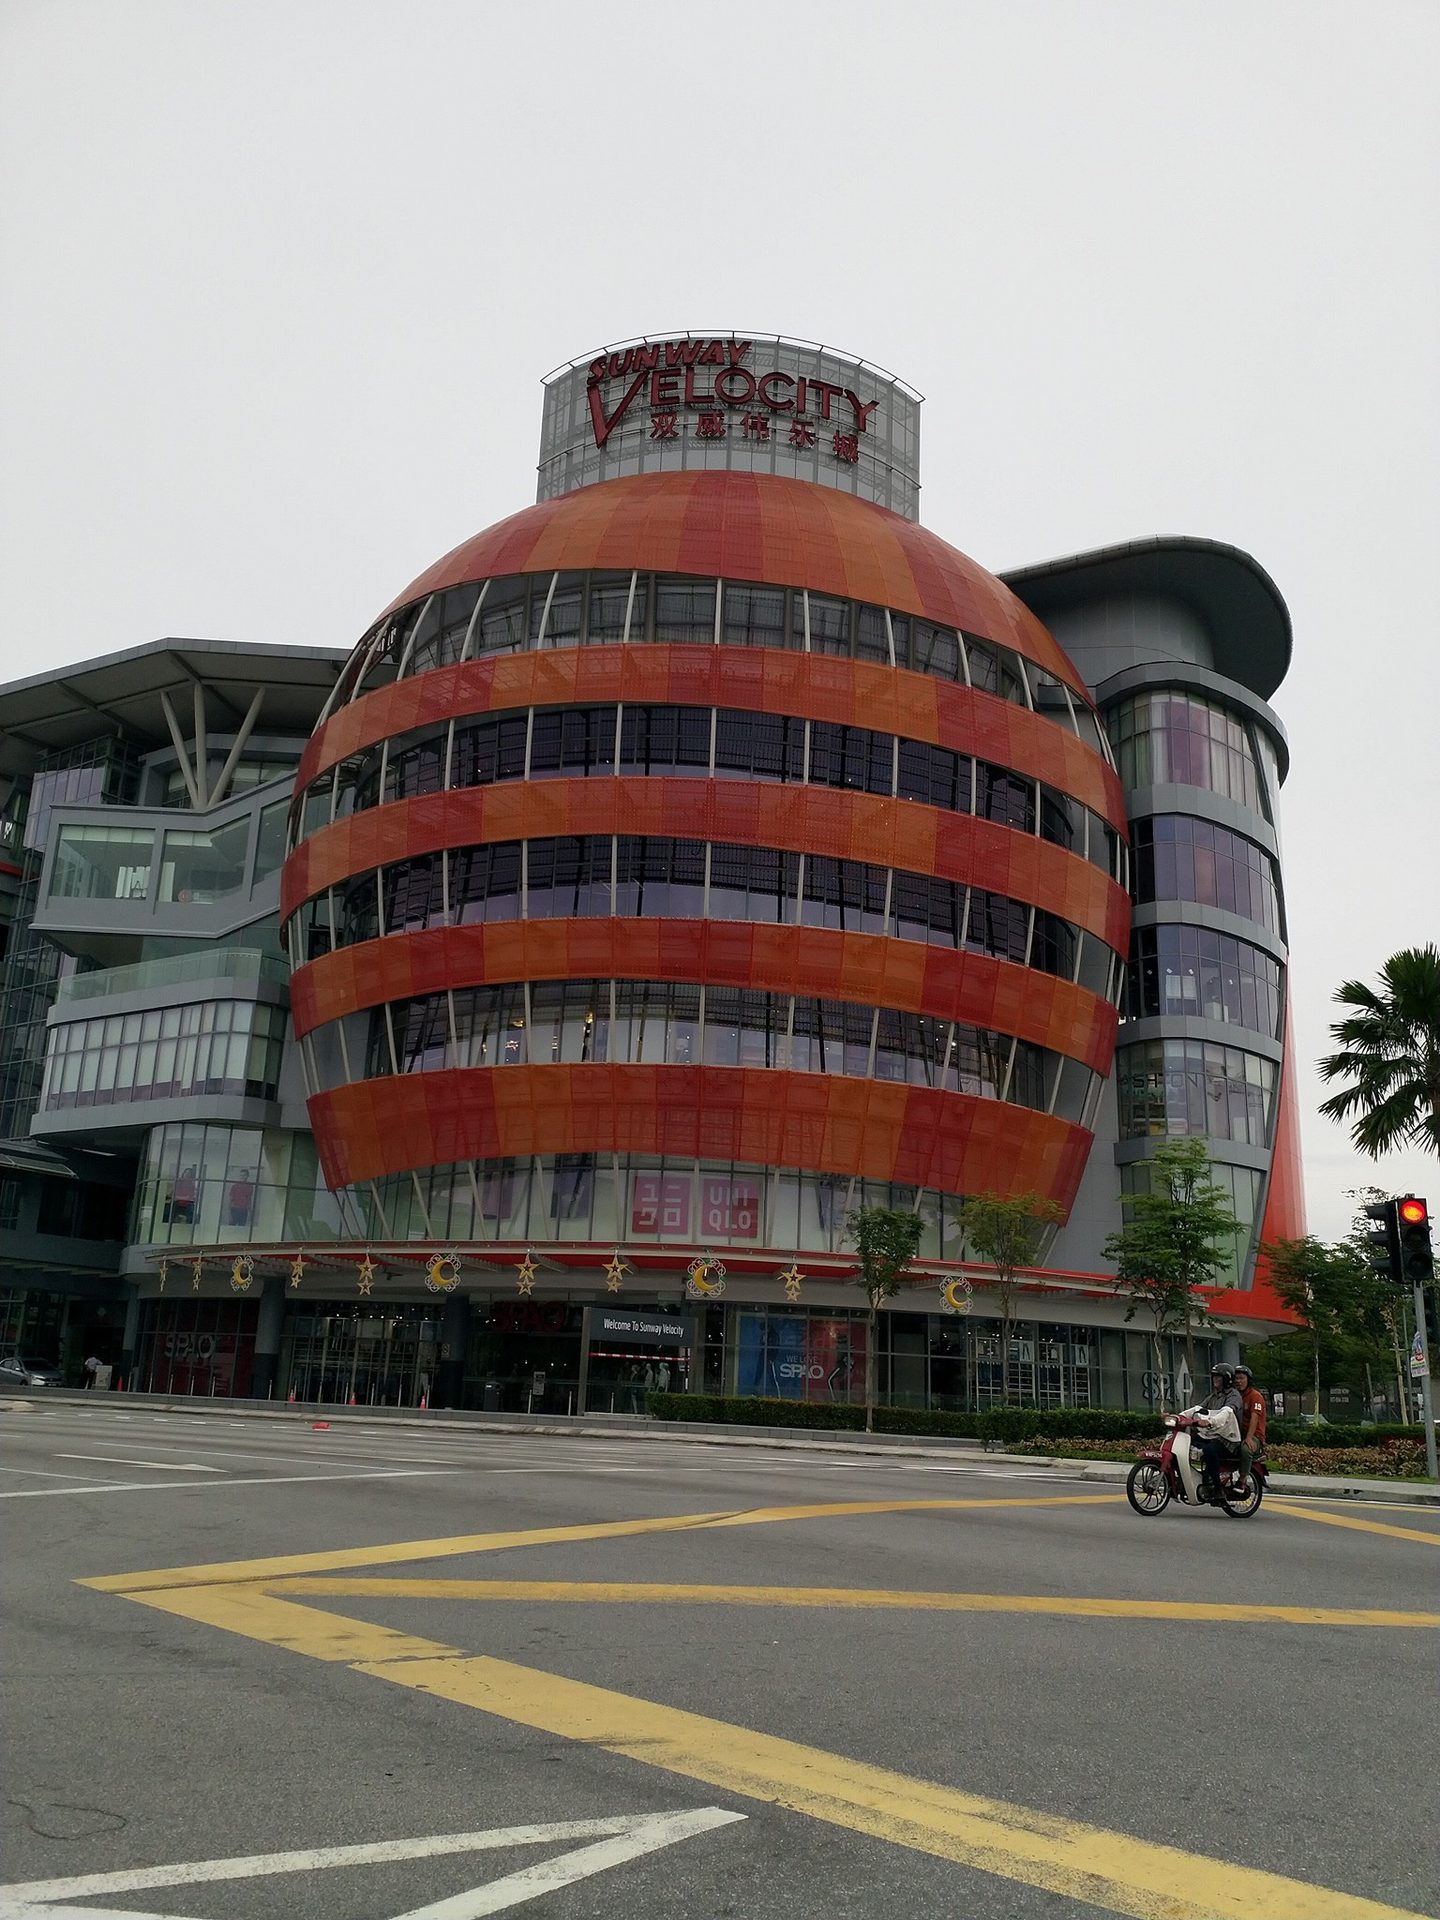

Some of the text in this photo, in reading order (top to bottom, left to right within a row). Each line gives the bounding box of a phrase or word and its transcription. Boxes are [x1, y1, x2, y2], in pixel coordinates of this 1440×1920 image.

[587, 340, 751, 385] SUNWAY
[586, 366, 880, 449] VELOCITY
[649, 409, 859, 464] 双威伟乐城
[641, 1184, 682, 1203] ユニ
[709, 1186, 749, 1206] UNI
[638, 1207, 681, 1227] クロ
[708, 1209, 751, 1232] QLO
[604, 1318, 685, 1338] Welcome To Sunway Velocity
[164, 1334, 214, 1359] SPAO
[786, 1354, 799, 1363] WE
[780, 1363, 825, 1379] SPAO
[1254, 1402, 1262, 1411] 19
